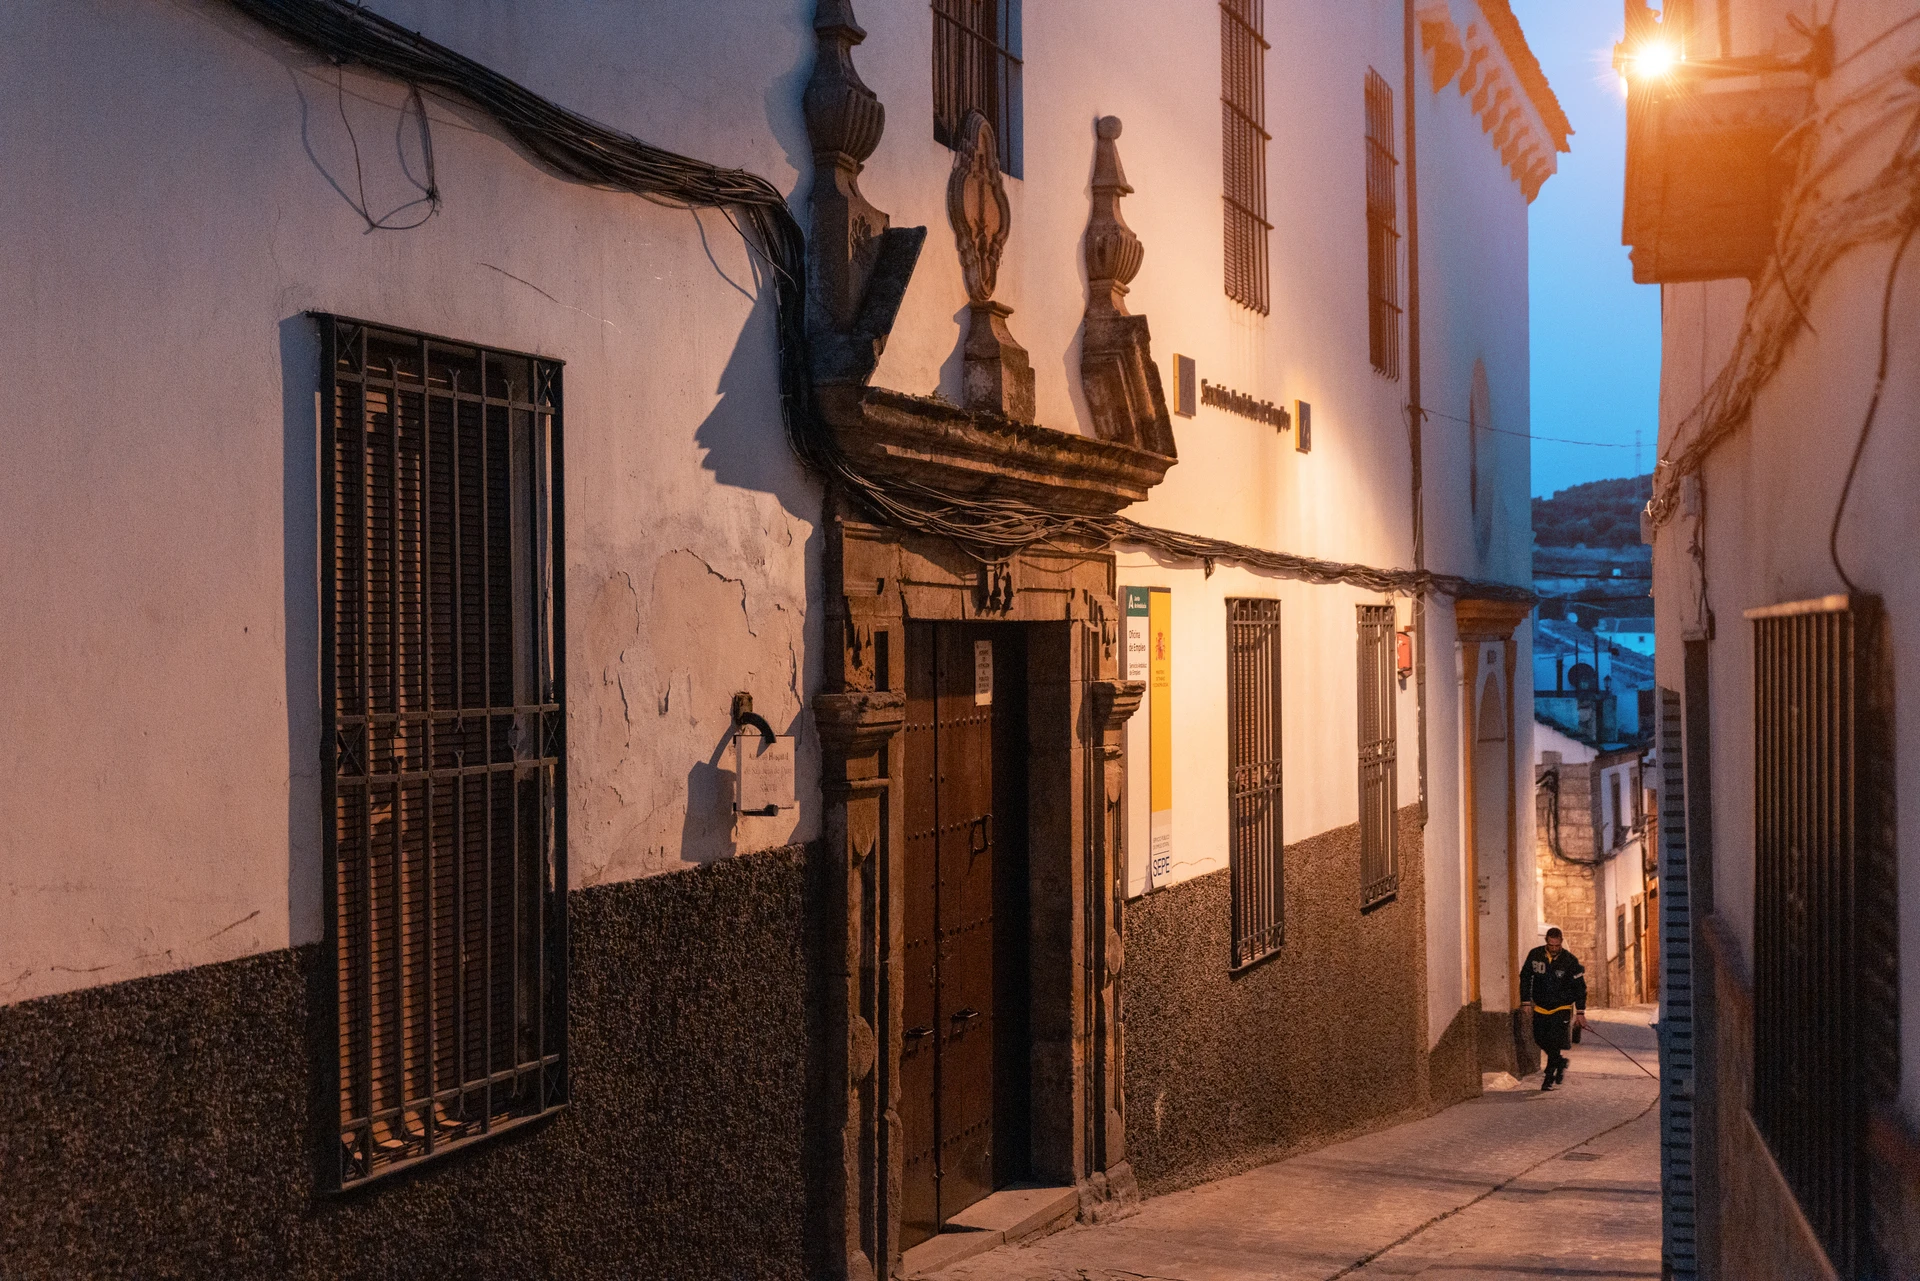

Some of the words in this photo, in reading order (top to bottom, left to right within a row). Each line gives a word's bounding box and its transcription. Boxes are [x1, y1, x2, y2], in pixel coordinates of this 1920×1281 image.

[1129, 629, 1141, 639] Oficina
[1133, 643, 1146, 653] Empleo
[1153, 856, 1170, 877] SEPE
